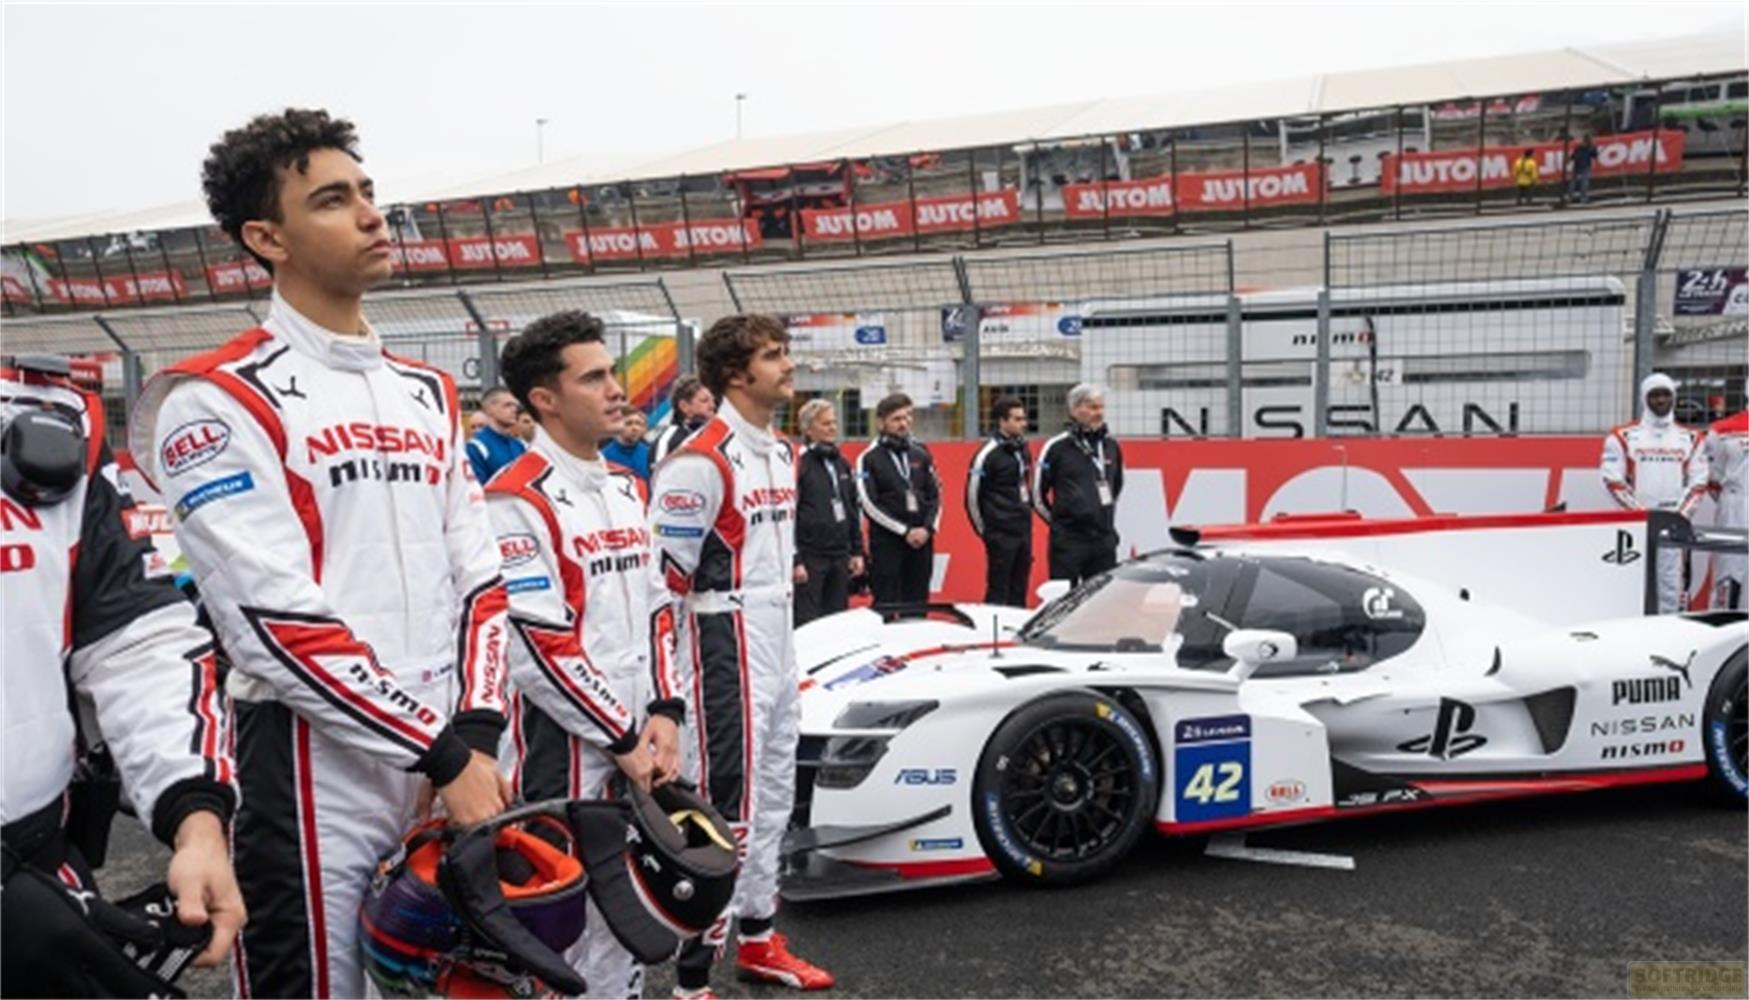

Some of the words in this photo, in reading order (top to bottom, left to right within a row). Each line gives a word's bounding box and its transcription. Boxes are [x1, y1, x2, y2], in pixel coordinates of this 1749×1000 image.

[1293, 331, 1374, 345] nimo
[1161, 402, 1519, 439] NSSAN
[1612, 675, 1681, 707] PUMA
[1590, 713, 1696, 737] NISSAN
[1601, 739, 1685, 760] nismo
[893, 768, 957, 786] ASUS
[1183, 761, 1244, 805] 42
